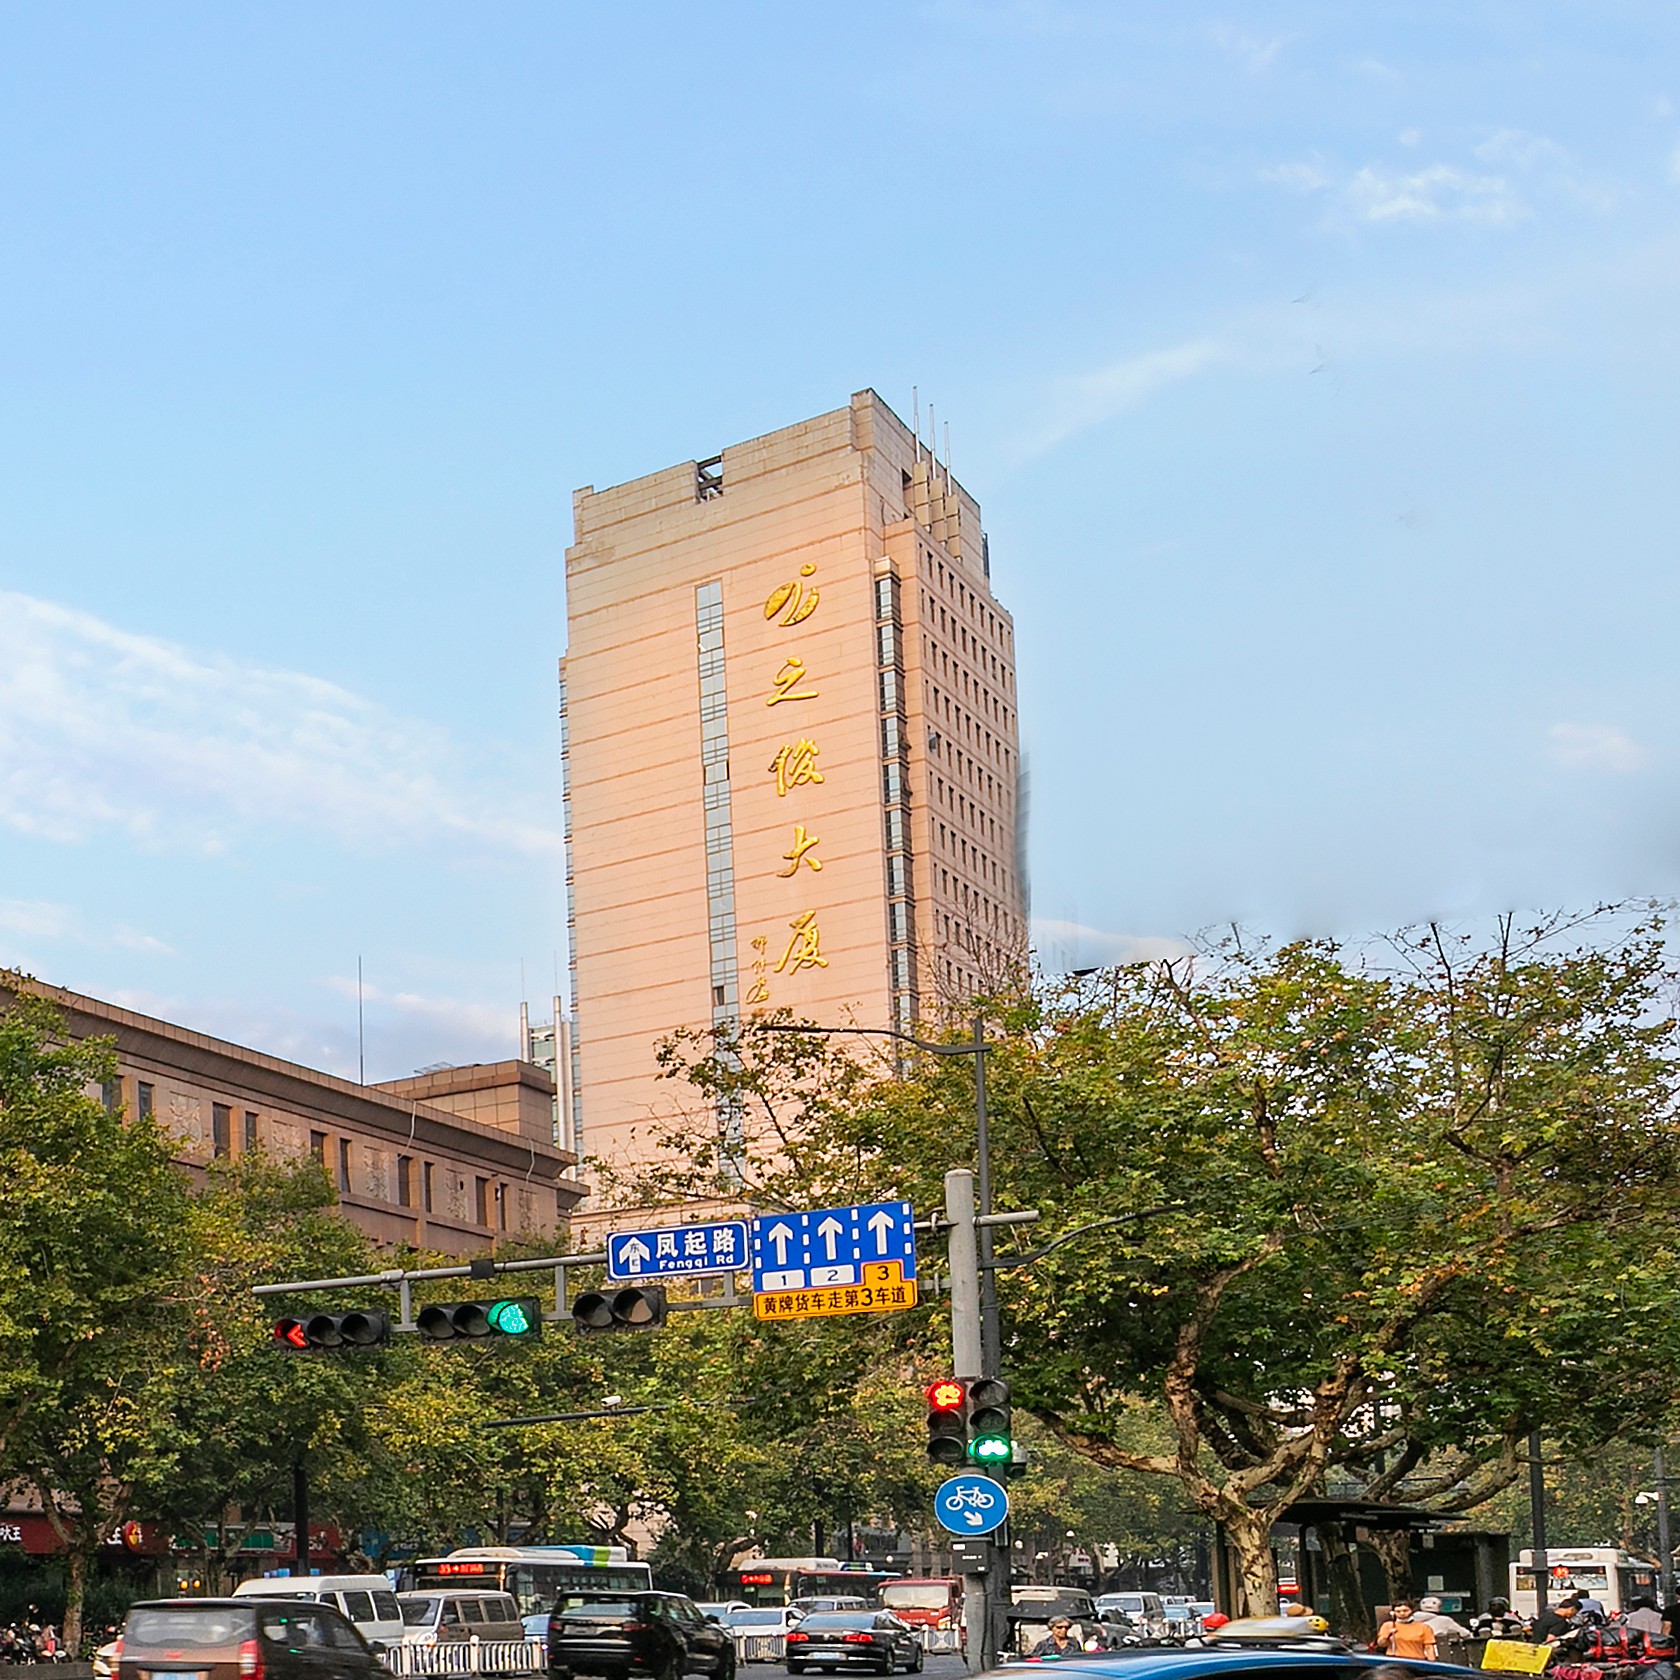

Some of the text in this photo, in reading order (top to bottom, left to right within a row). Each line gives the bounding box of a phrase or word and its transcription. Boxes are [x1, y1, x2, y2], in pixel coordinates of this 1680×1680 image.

[656, 1227, 736, 1259] 凤起路
[659, 1254, 734, 1270] Fengqi Rd
[781, 1274, 787, 1286] 1
[827, 1269, 839, 1282] 2
[877, 1265, 890, 1280] 3
[763, 1285, 906, 1315] 黄牌货车走第3车道
